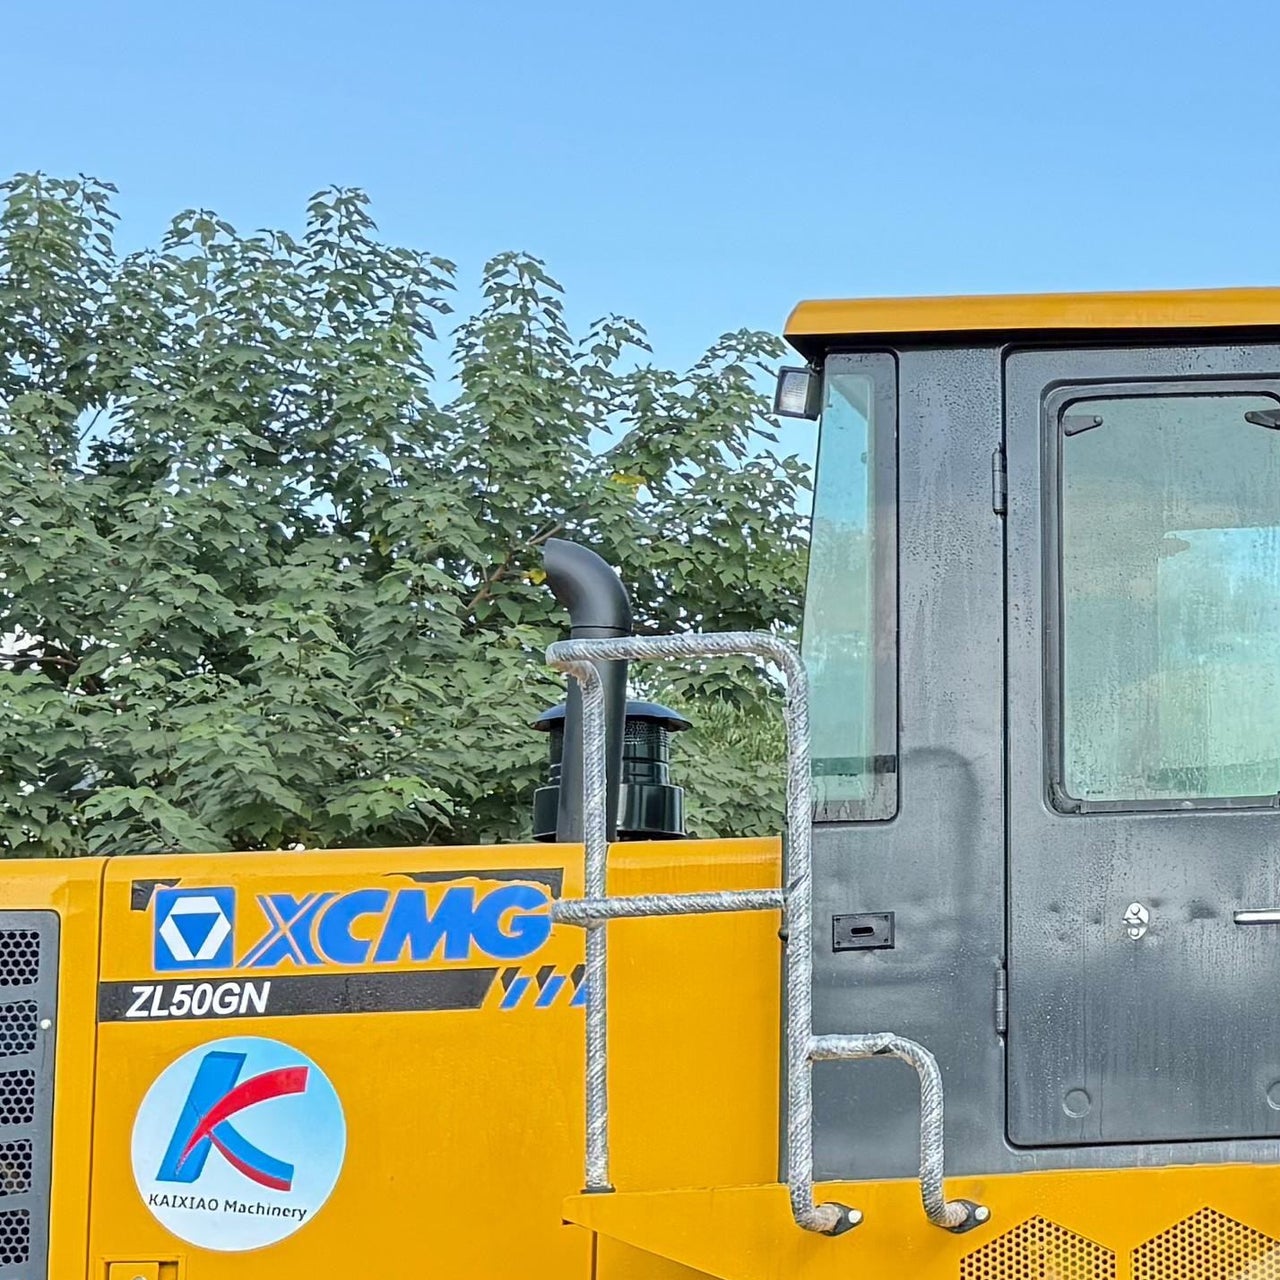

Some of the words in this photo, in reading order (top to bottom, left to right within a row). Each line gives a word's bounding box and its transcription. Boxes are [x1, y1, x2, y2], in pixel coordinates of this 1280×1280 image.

[235, 885, 553, 968] XCMG
[125, 981, 270, 1018] ZL50GN
[148, 1193, 219, 1211] KAIXIAO
[223, 1199, 307, 1221] Machinery
